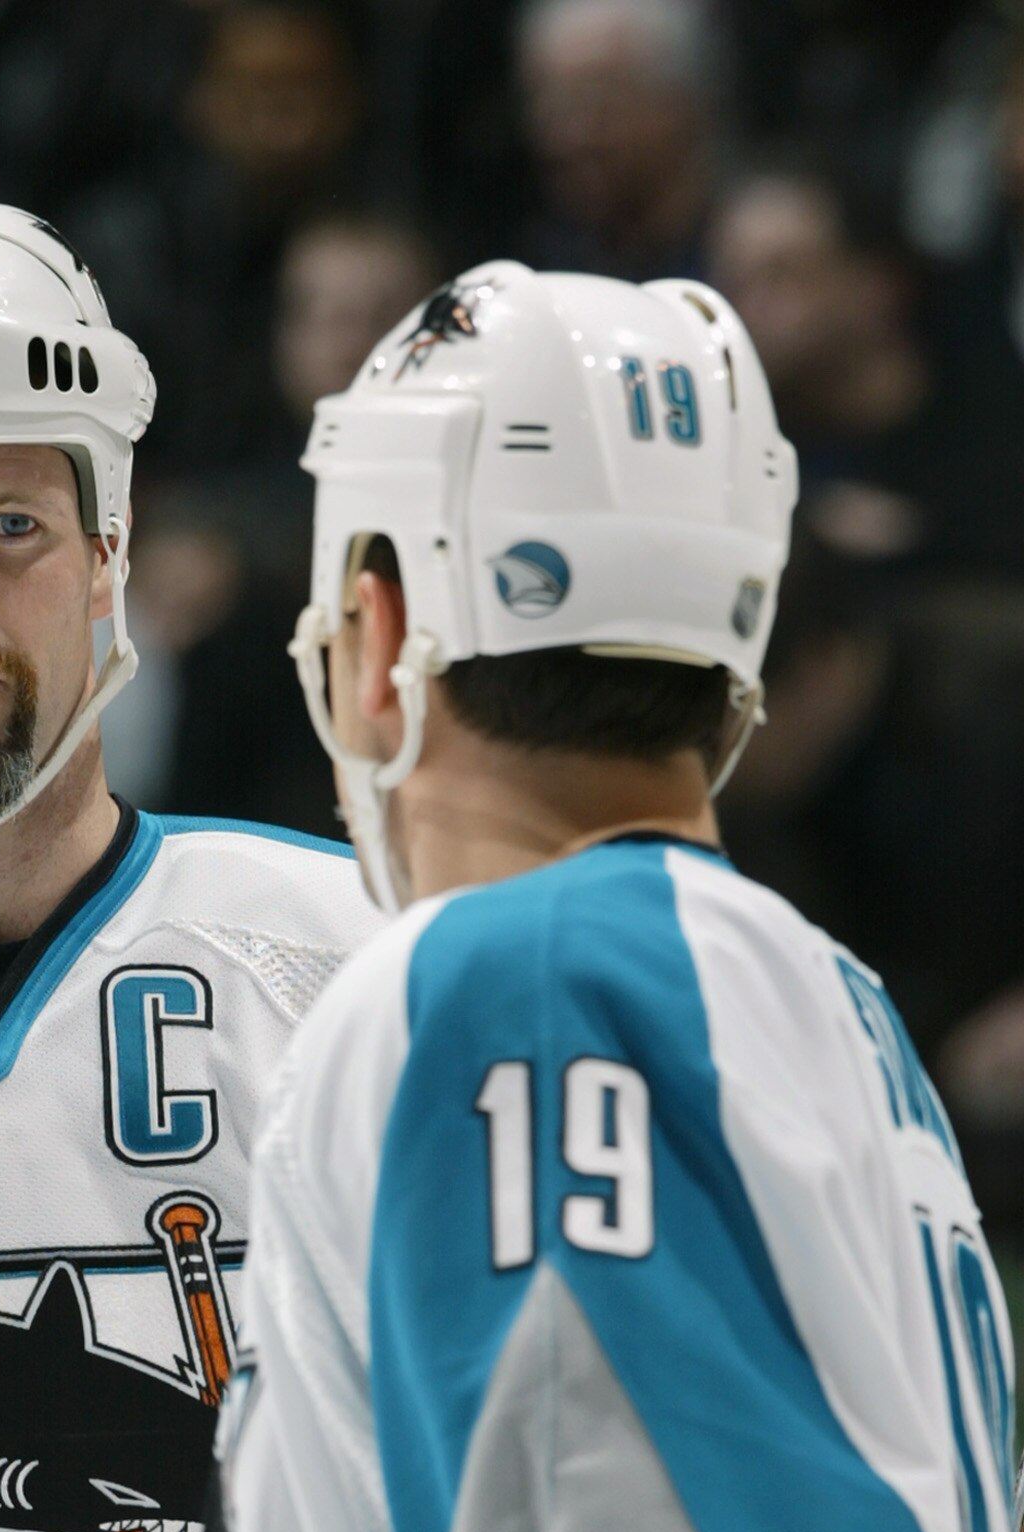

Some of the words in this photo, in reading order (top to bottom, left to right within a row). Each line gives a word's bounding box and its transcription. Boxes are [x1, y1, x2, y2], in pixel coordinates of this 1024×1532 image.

[621, 355, 703, 449] 19
[99, 963, 219, 1168] C
[473, 1054, 657, 1272] 19
